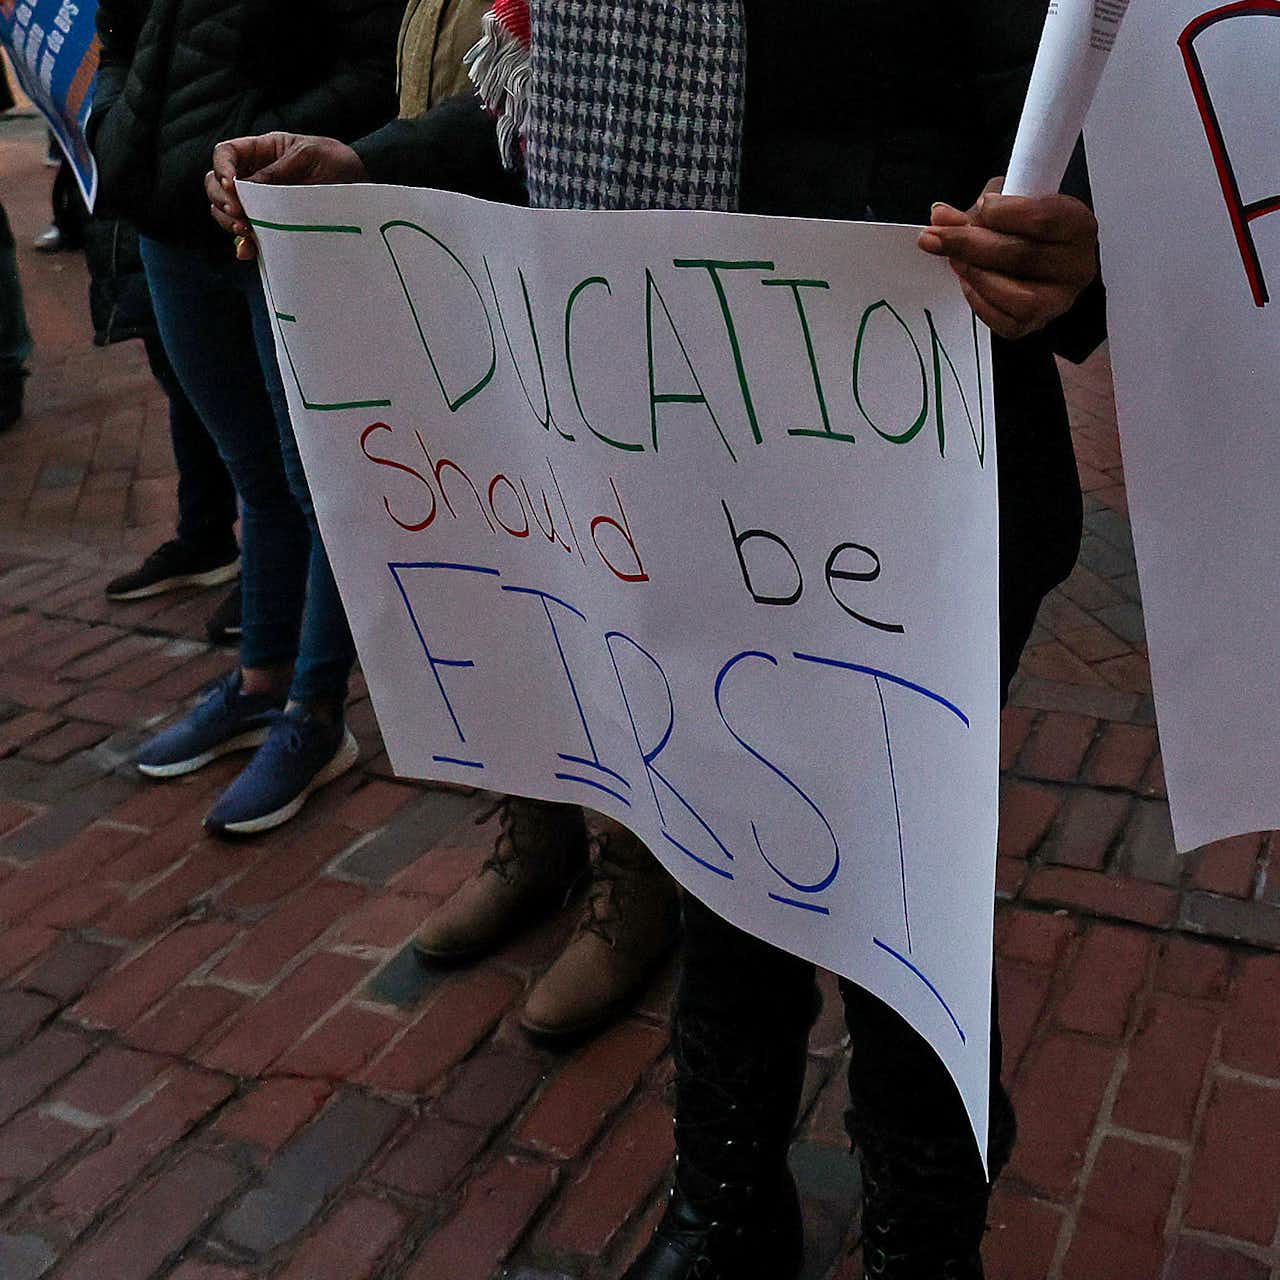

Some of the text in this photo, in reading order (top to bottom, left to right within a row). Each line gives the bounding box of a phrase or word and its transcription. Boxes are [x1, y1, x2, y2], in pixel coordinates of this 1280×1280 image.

[247, 219, 992, 470] EDUCATION
[360, 421, 906, 634] Should be
[386, 561, 971, 1046] FIRST
